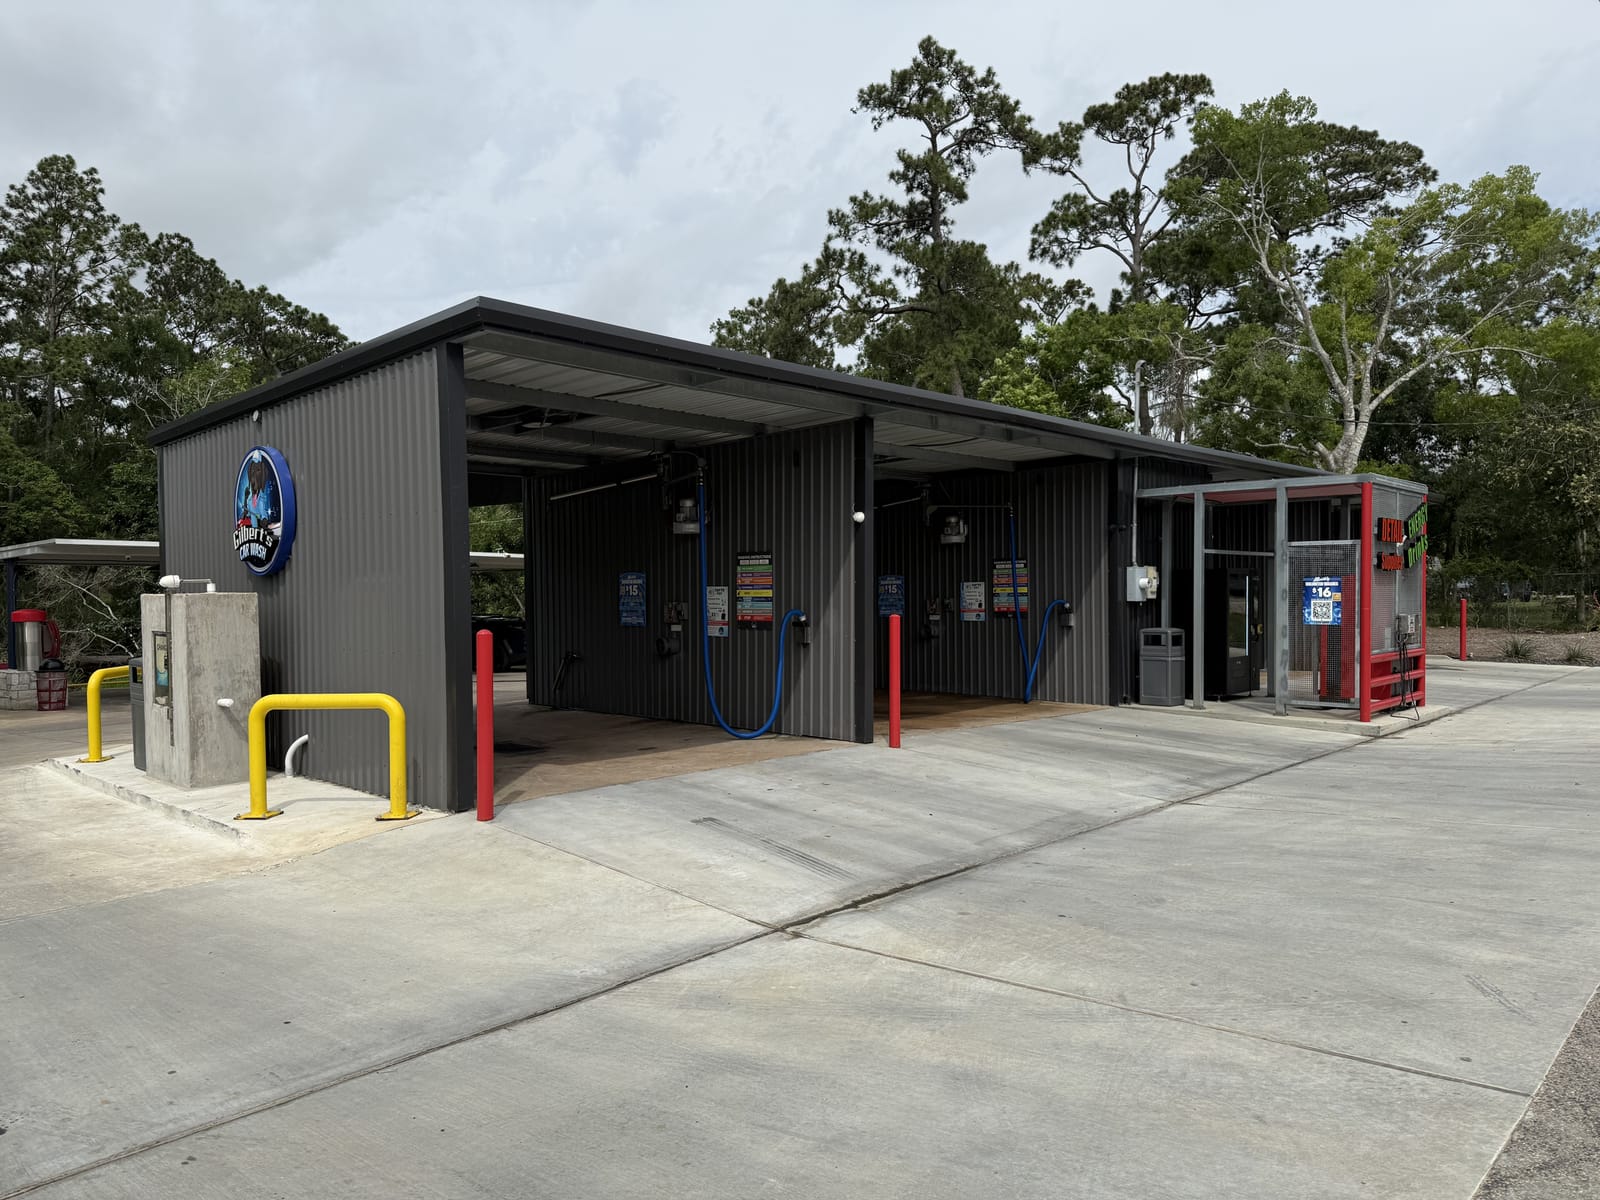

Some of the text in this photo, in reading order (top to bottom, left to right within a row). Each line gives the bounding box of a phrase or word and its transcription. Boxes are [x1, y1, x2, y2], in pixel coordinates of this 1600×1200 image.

[1382, 517, 1403, 543] DETAIL
[1408, 503, 1428, 539] ENERGY
[233, 526, 273, 549] Gilbert's
[239, 543, 266, 560] CAR WASH
